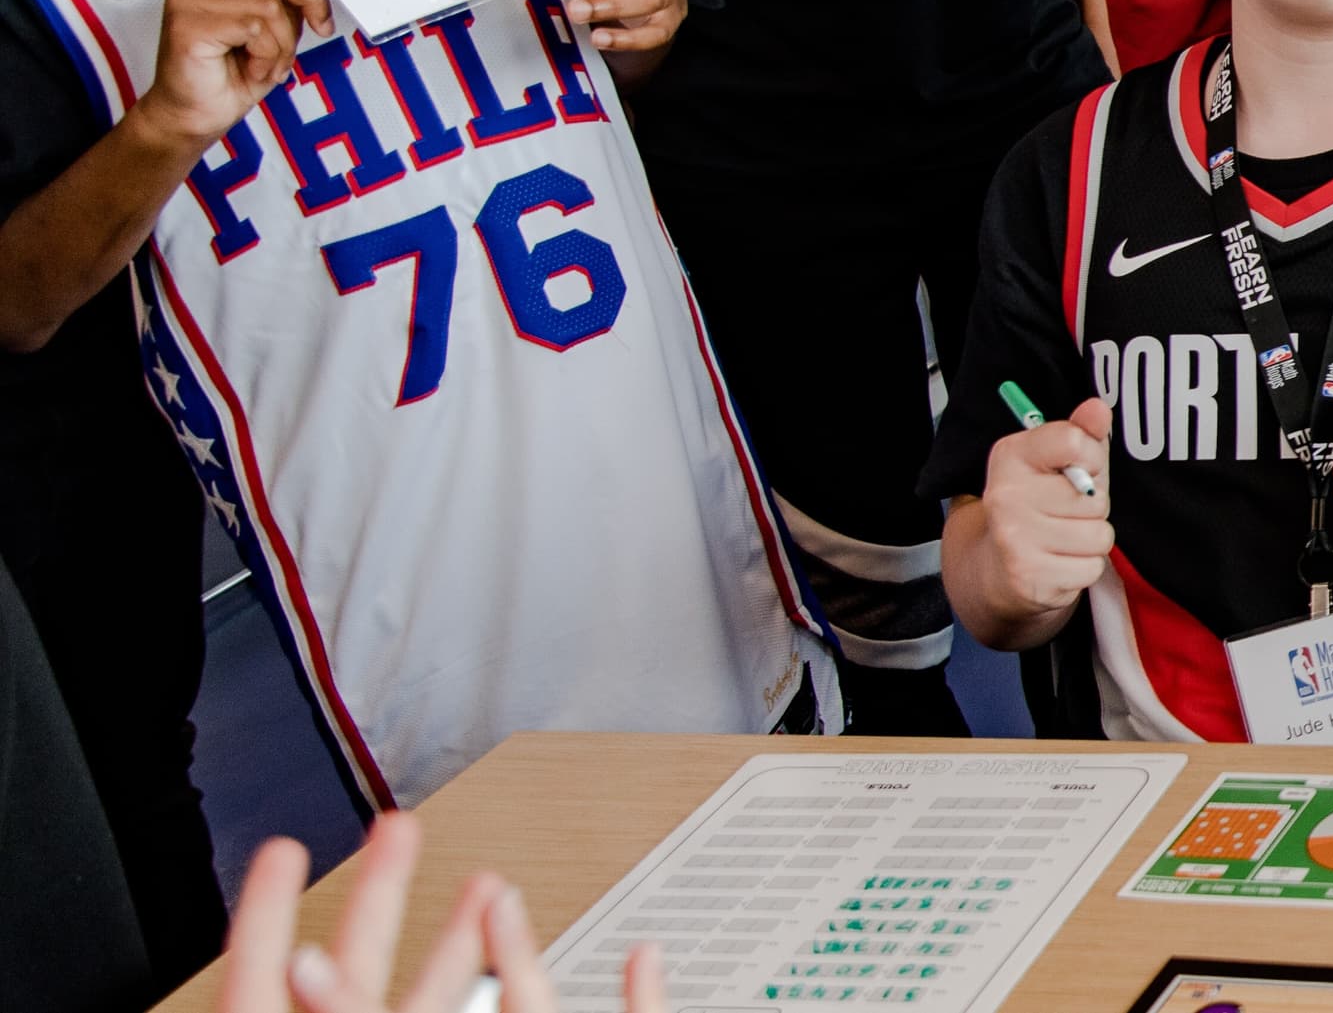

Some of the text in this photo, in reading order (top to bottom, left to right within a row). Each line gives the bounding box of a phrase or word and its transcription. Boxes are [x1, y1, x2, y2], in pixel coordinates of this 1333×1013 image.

[1221, 227, 1258, 310] FRESH
[1235, 221, 1274, 305] LEARN
[320, 163, 627, 408] 76
[1265, 366, 1285, 389] Hoops
[1281, 359, 1299, 380] Math
[1285, 719, 1324, 740] Jude
[840, 759, 1078, 775] BASIC GAME
